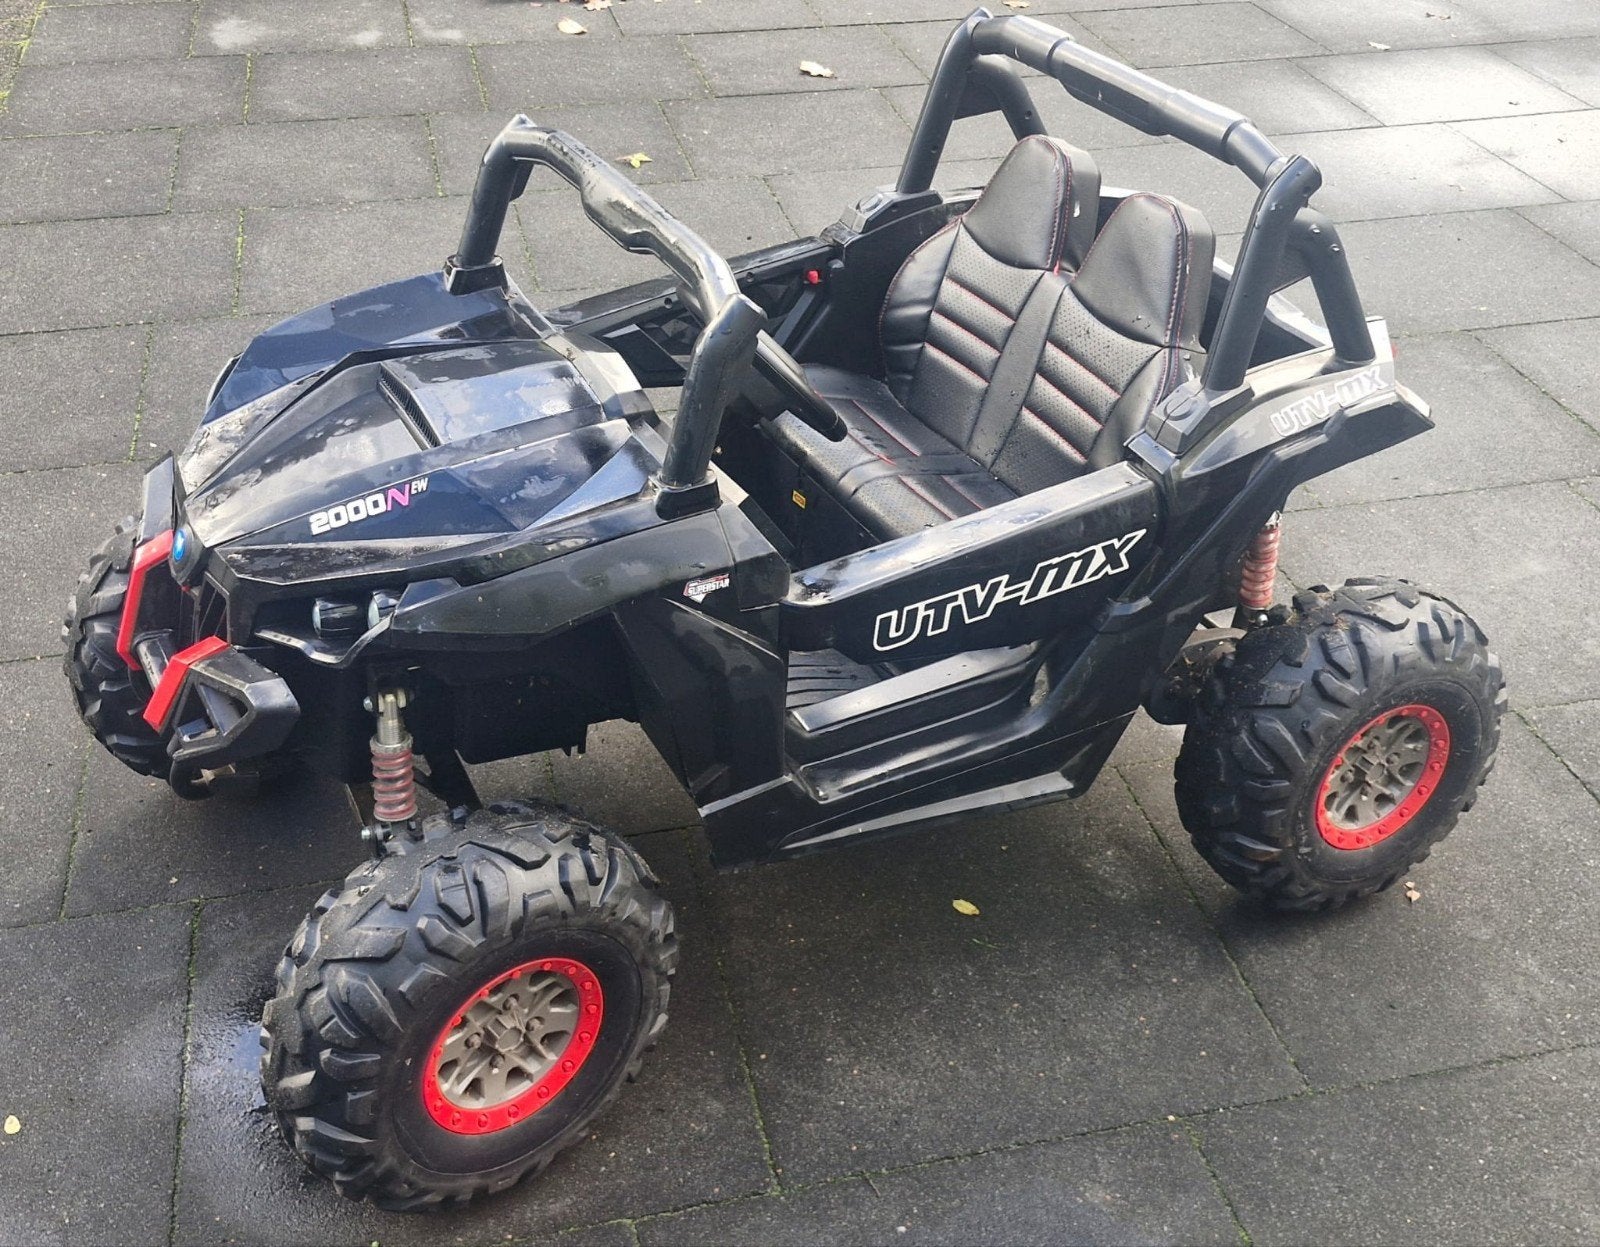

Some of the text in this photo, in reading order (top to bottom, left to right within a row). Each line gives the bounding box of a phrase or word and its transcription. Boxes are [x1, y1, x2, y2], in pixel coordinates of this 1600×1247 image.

[1270, 366, 1389, 437] UTV-MX
[687, 578, 730, 596] SUPERSTAR
[873, 528, 1147, 651] UTV-MX
